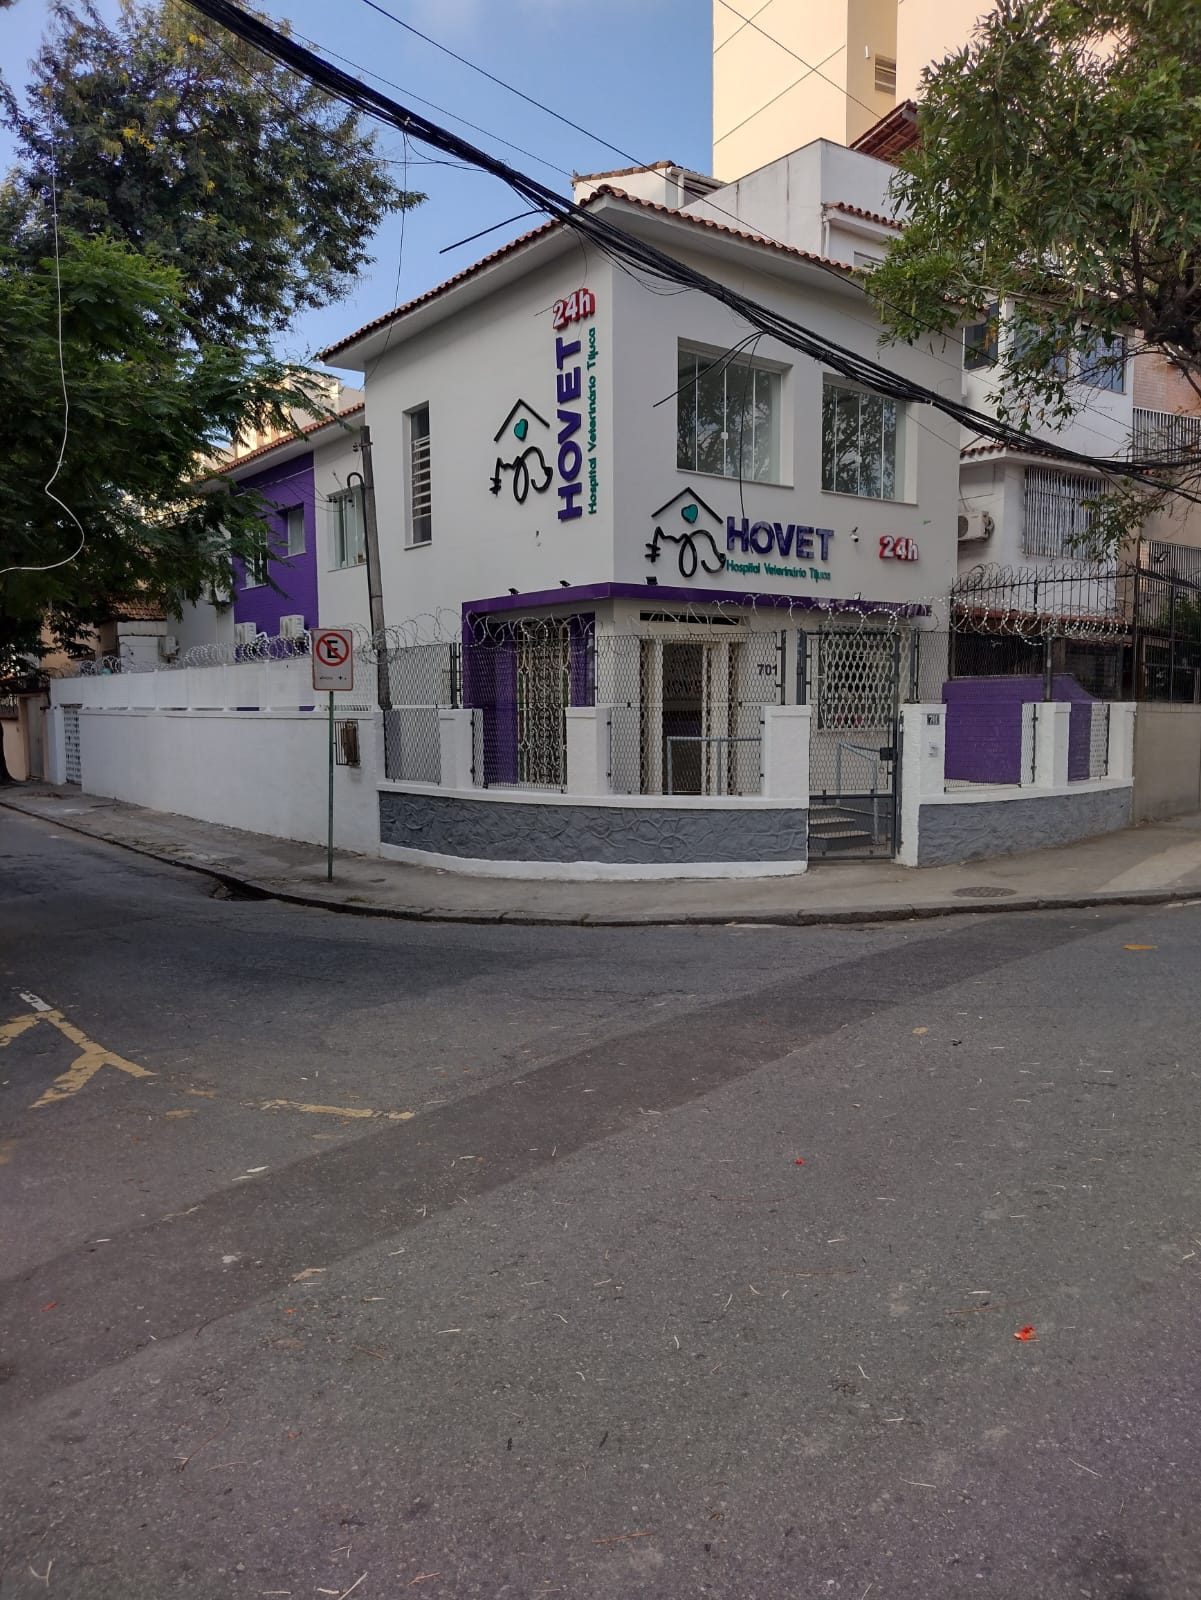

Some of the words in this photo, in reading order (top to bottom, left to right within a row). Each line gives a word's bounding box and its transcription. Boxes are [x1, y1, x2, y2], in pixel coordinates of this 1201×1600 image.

[553, 288, 596, 330] 24h
[587, 327, 598, 370] Tijuca
[556, 337, 583, 522] HOVET
[587, 375, 597, 453] Veterinário
[588, 457, 597, 515] Hospital
[726, 516, 835, 561] HOVET
[879, 535, 919, 562] 24h
[726, 560, 760, 575] Hospital
[764, 562, 807, 578] Veterinário
[809, 567, 831, 583] Tijuca
[327, 640, 339, 658] E
[757, 663, 777, 676] 701
